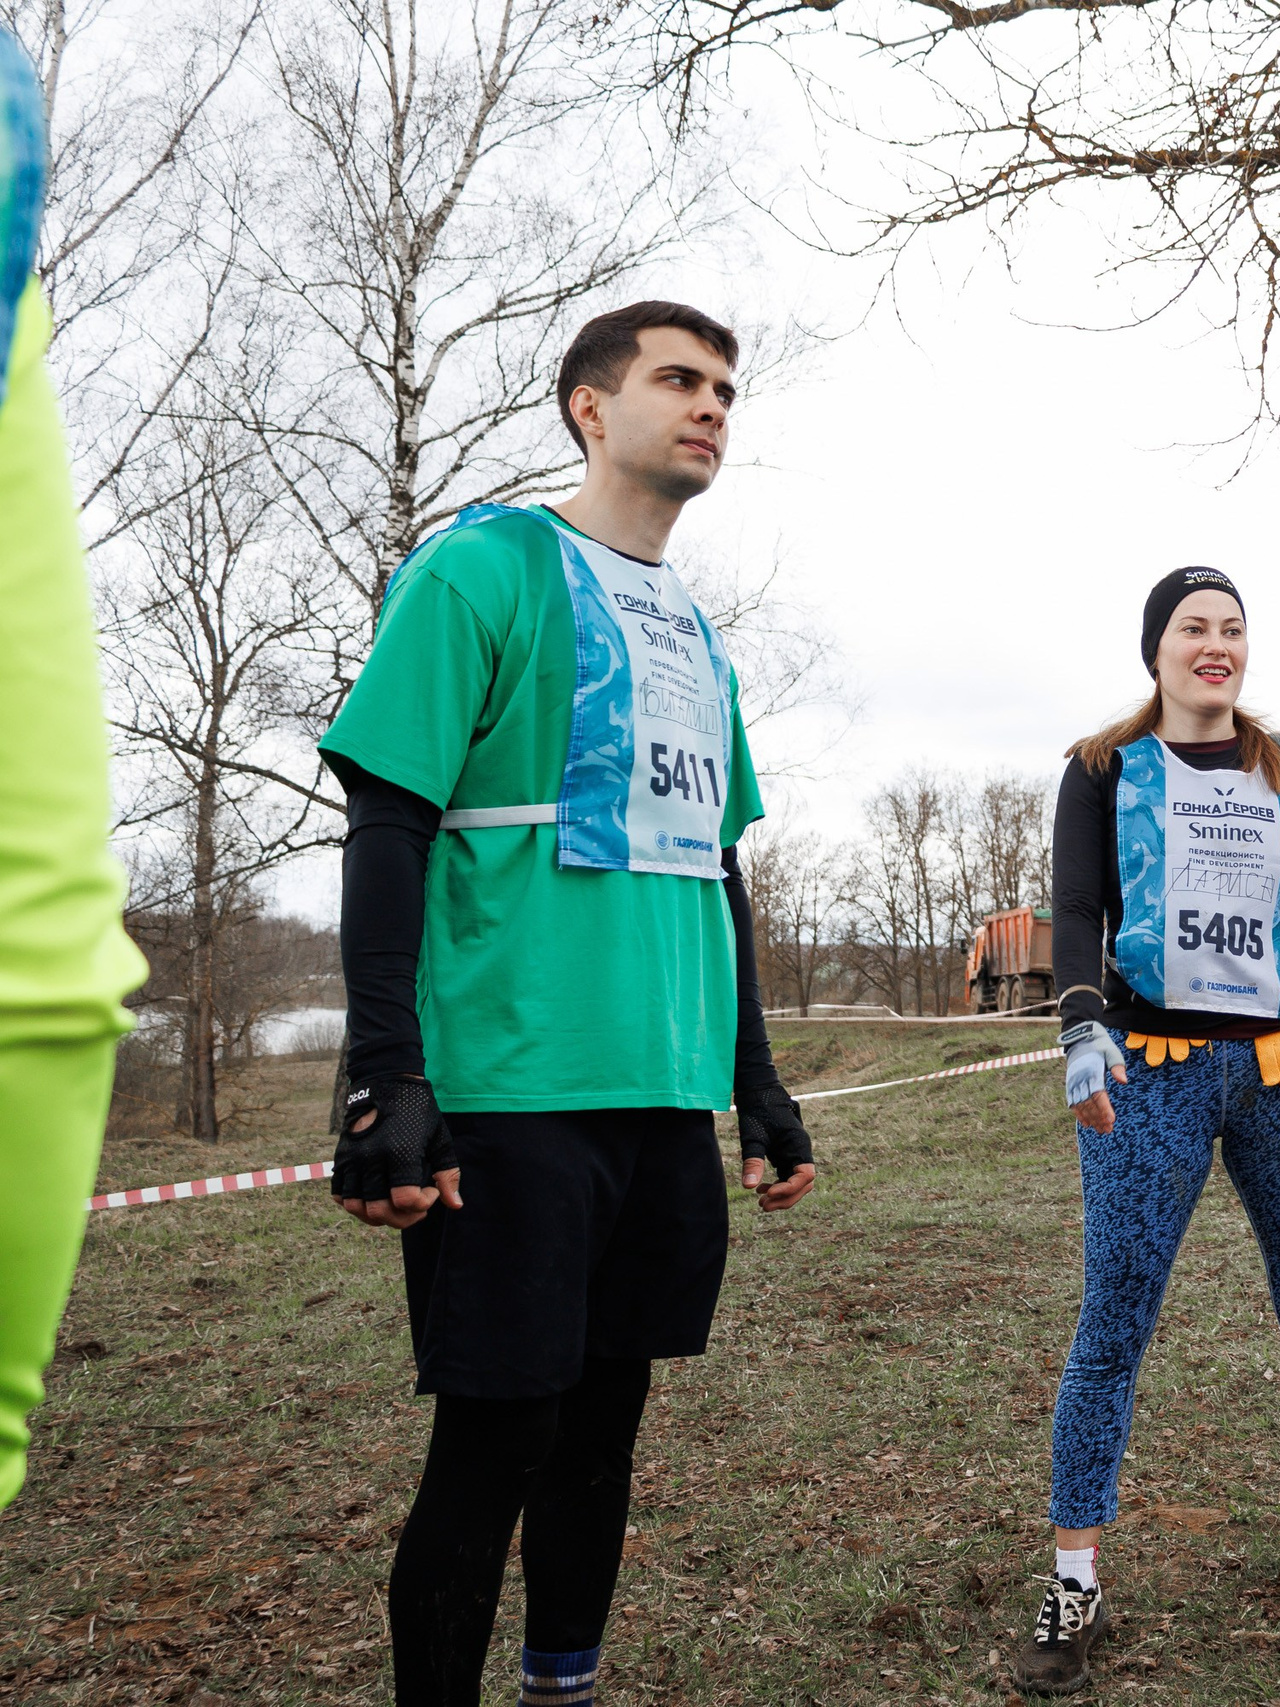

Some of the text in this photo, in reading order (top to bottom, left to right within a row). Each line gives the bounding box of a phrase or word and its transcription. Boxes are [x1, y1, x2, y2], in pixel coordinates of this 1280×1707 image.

[1196, 576, 1226, 586] team
[613, 593, 660, 615] ГОНКА
[651, 671, 666, 682] FINE
[650, 742, 720, 807] 5411
[1173, 801, 1275, 818] ГОНКА ГЕРОЕВ
[1189, 822, 1264, 844] Sminex
[1188, 848, 1265, 860] ПЕРФЕКЦИОНИСТЫ
[1188, 858, 1264, 869] FINE DEVELOPMENT
[1178, 909, 1264, 960] 5405
[1207, 981, 1258, 995] ГАЗПРОМБАНК
